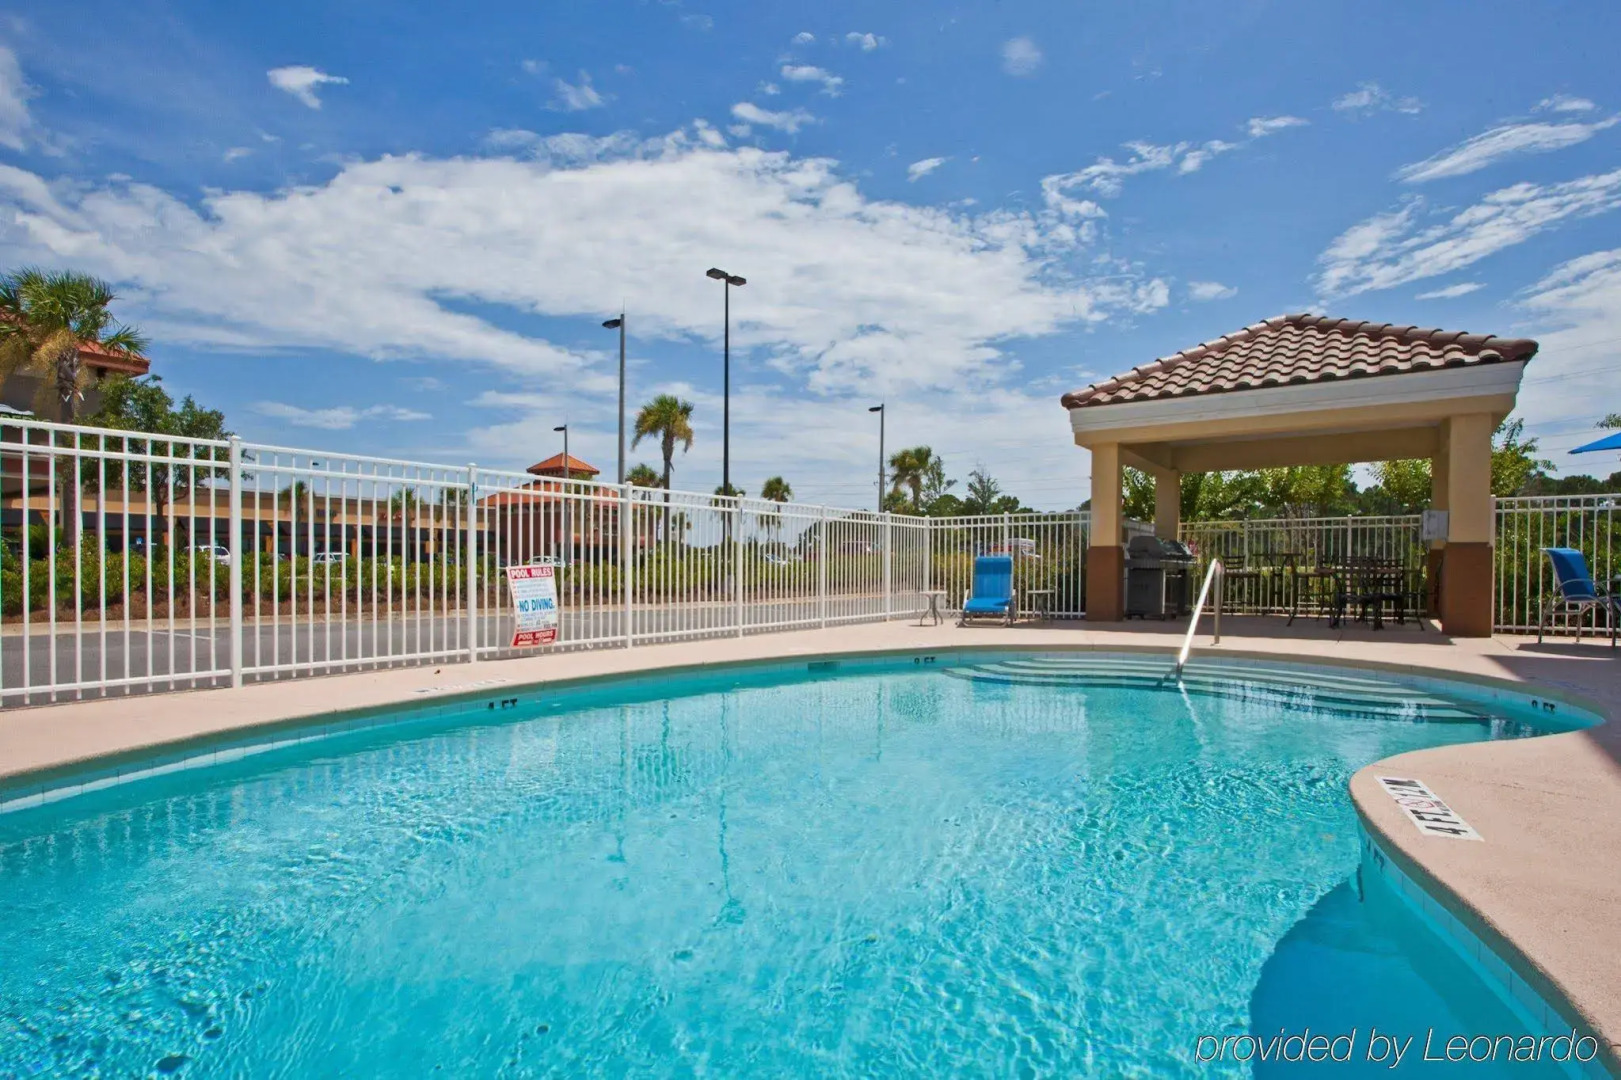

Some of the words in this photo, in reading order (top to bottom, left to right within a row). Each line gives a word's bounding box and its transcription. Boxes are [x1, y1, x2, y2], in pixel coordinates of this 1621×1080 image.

[511, 568, 530, 579] POOL
[531, 567, 552, 578] RULES
[519, 600, 530, 612] NO
[518, 632, 534, 641] POOL
[535, 629, 553, 640] HOURS
